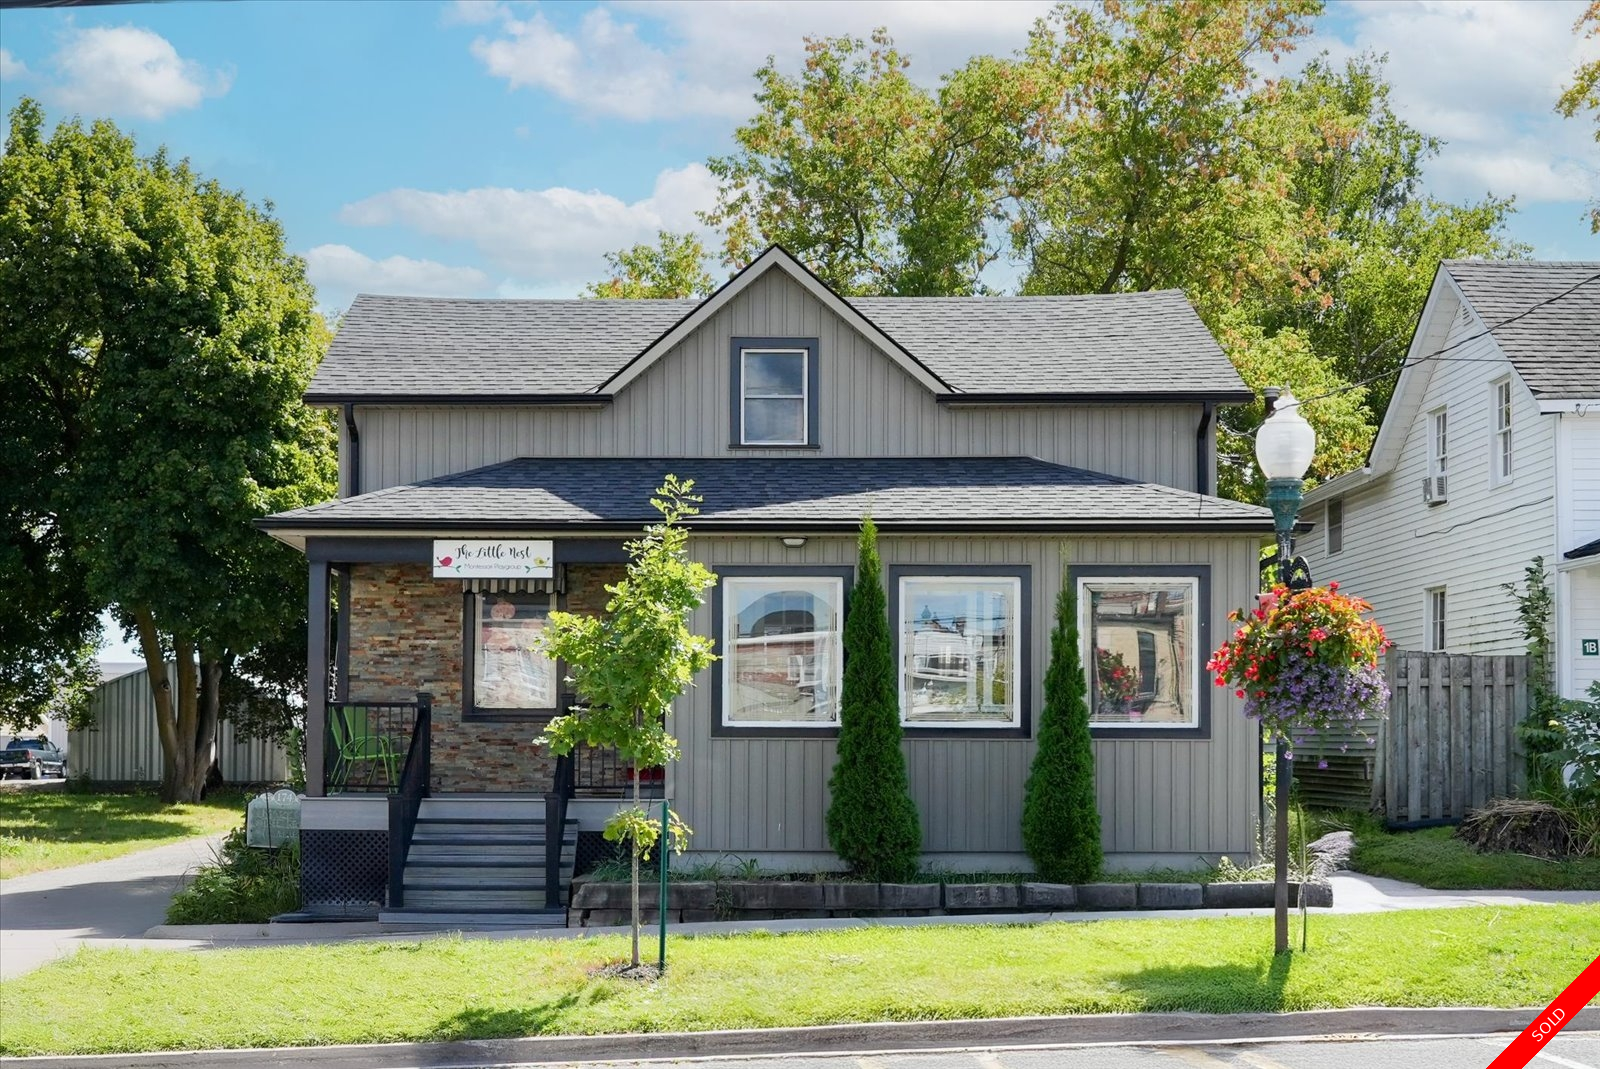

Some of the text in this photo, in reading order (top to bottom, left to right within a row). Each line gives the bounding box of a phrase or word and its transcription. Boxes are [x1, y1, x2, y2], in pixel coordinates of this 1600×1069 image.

[455, 544, 531, 559] The Little Nest
[494, 563, 522, 571] Playgroup
[1584, 642, 1598, 653] 1B
[277, 793, 293, 802] 174
